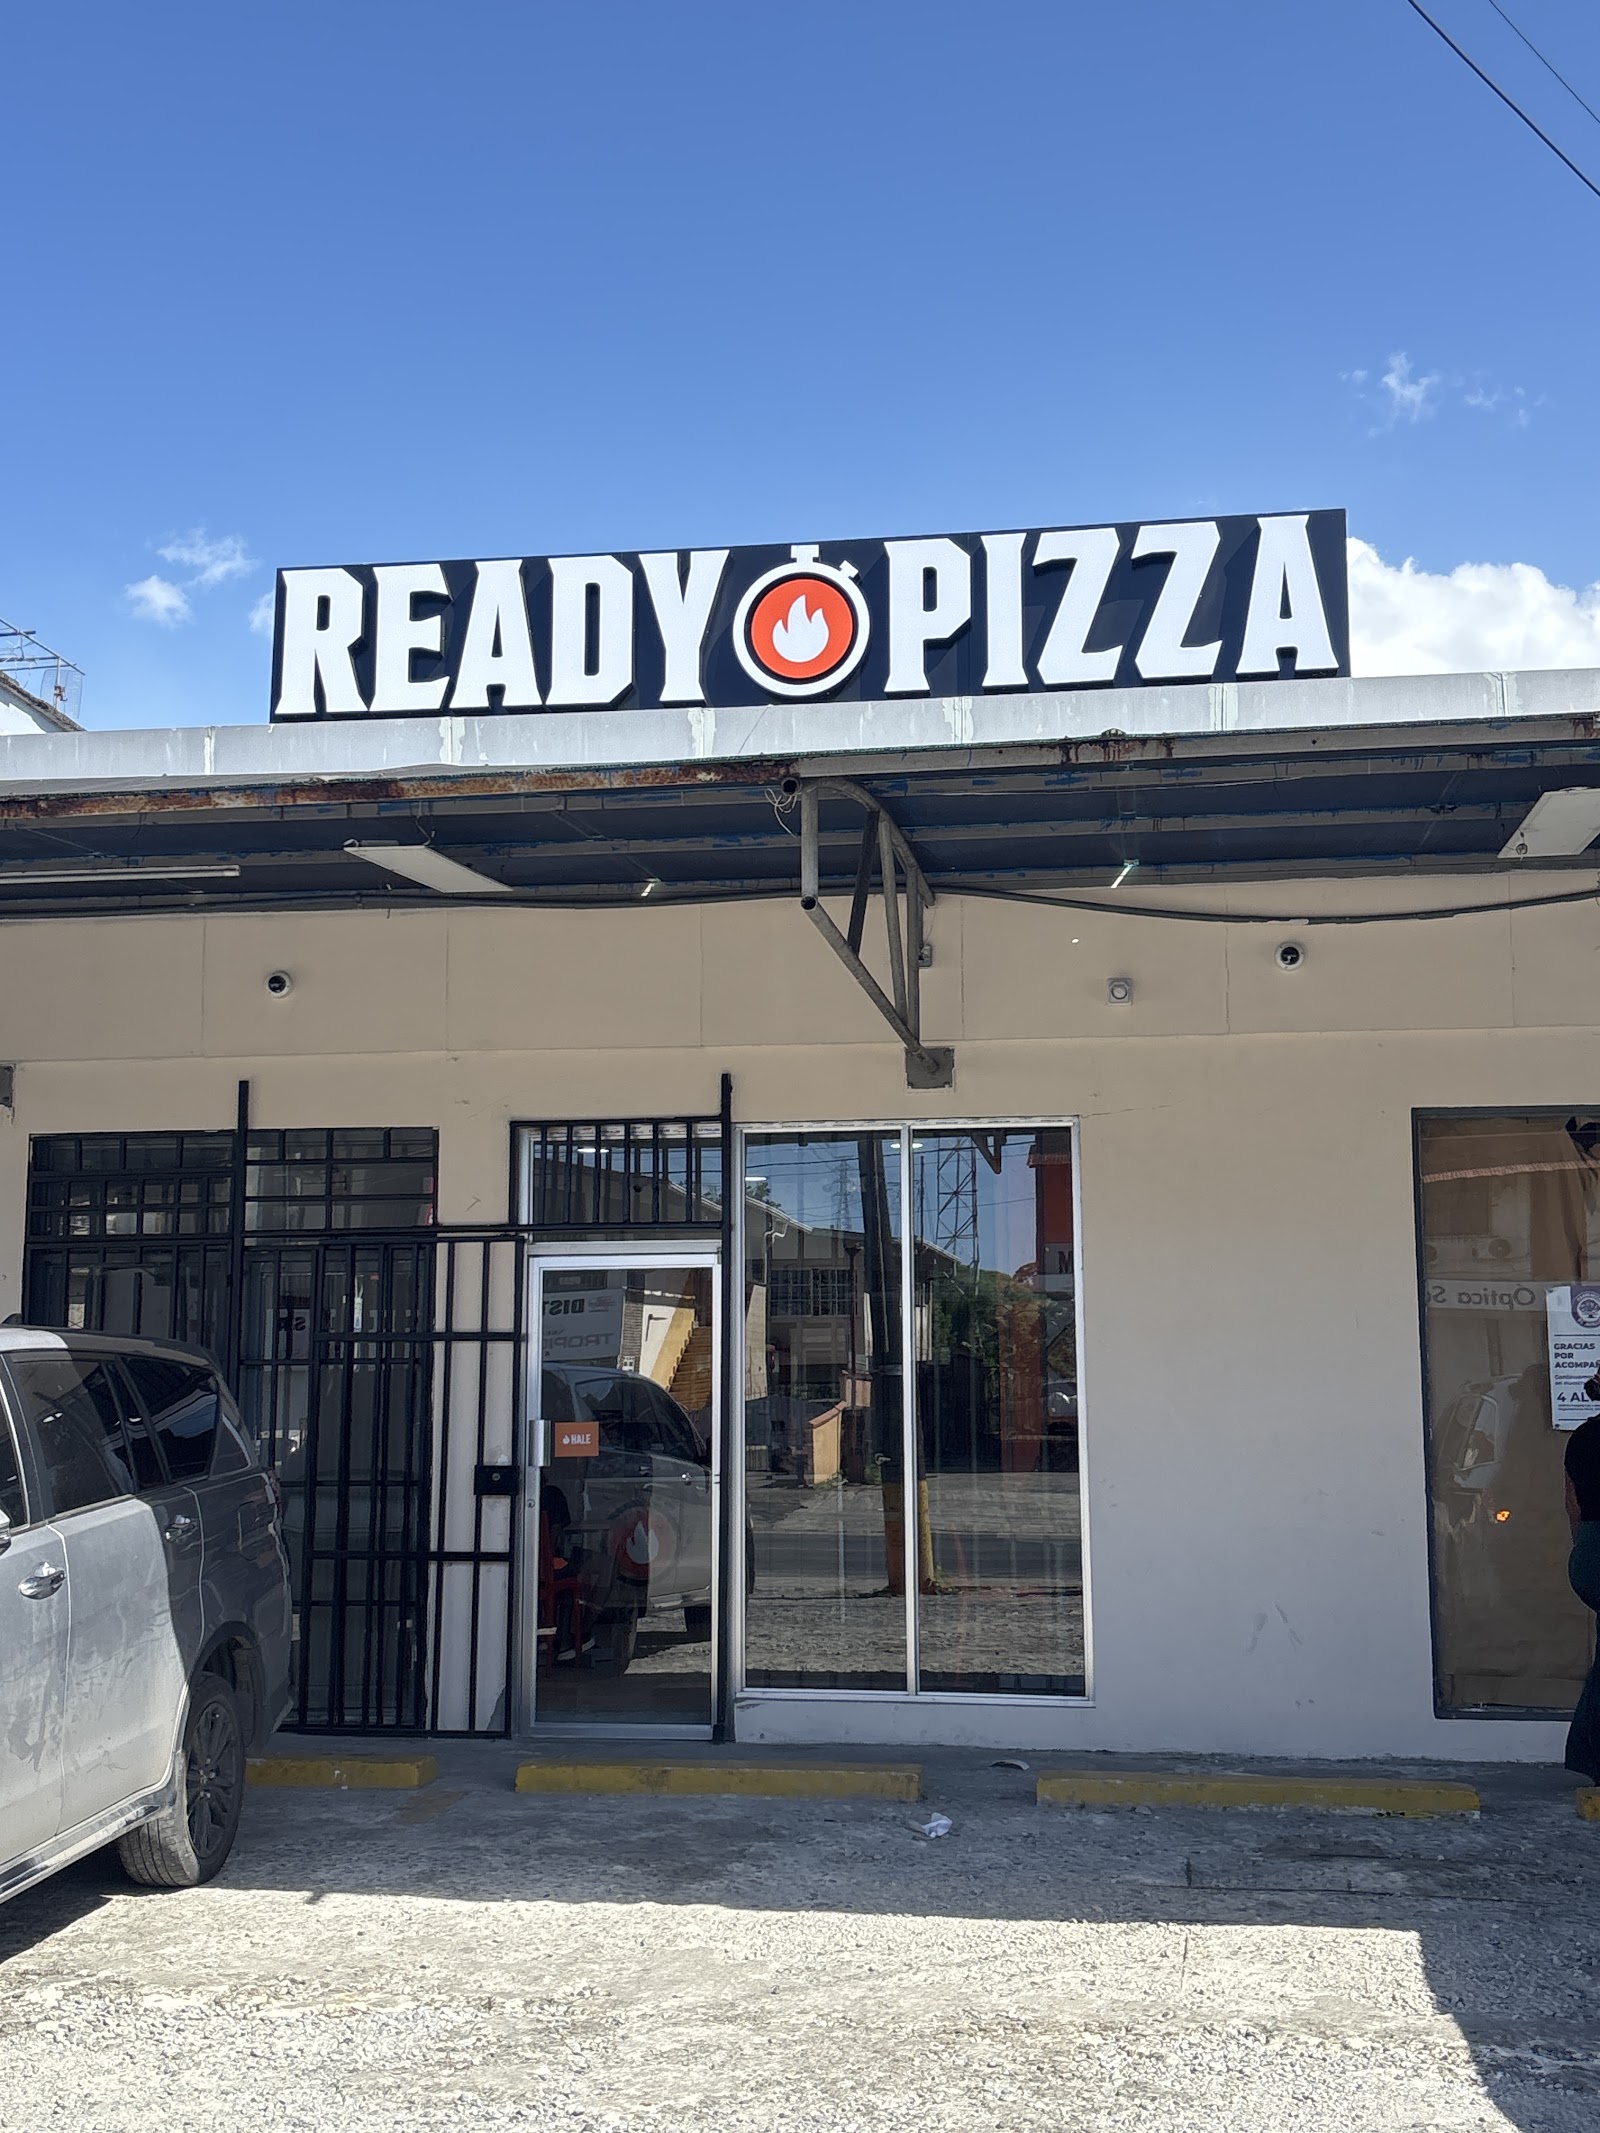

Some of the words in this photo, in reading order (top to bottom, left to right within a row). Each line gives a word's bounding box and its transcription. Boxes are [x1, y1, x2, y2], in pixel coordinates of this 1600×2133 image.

[276, 550, 731, 715] READY
[884, 514, 1340, 692] PIZZA
[1557, 1392, 1566, 1402] 4
[1570, 1391, 1590, 1402] AL
[571, 1434, 591, 1445] HALE
